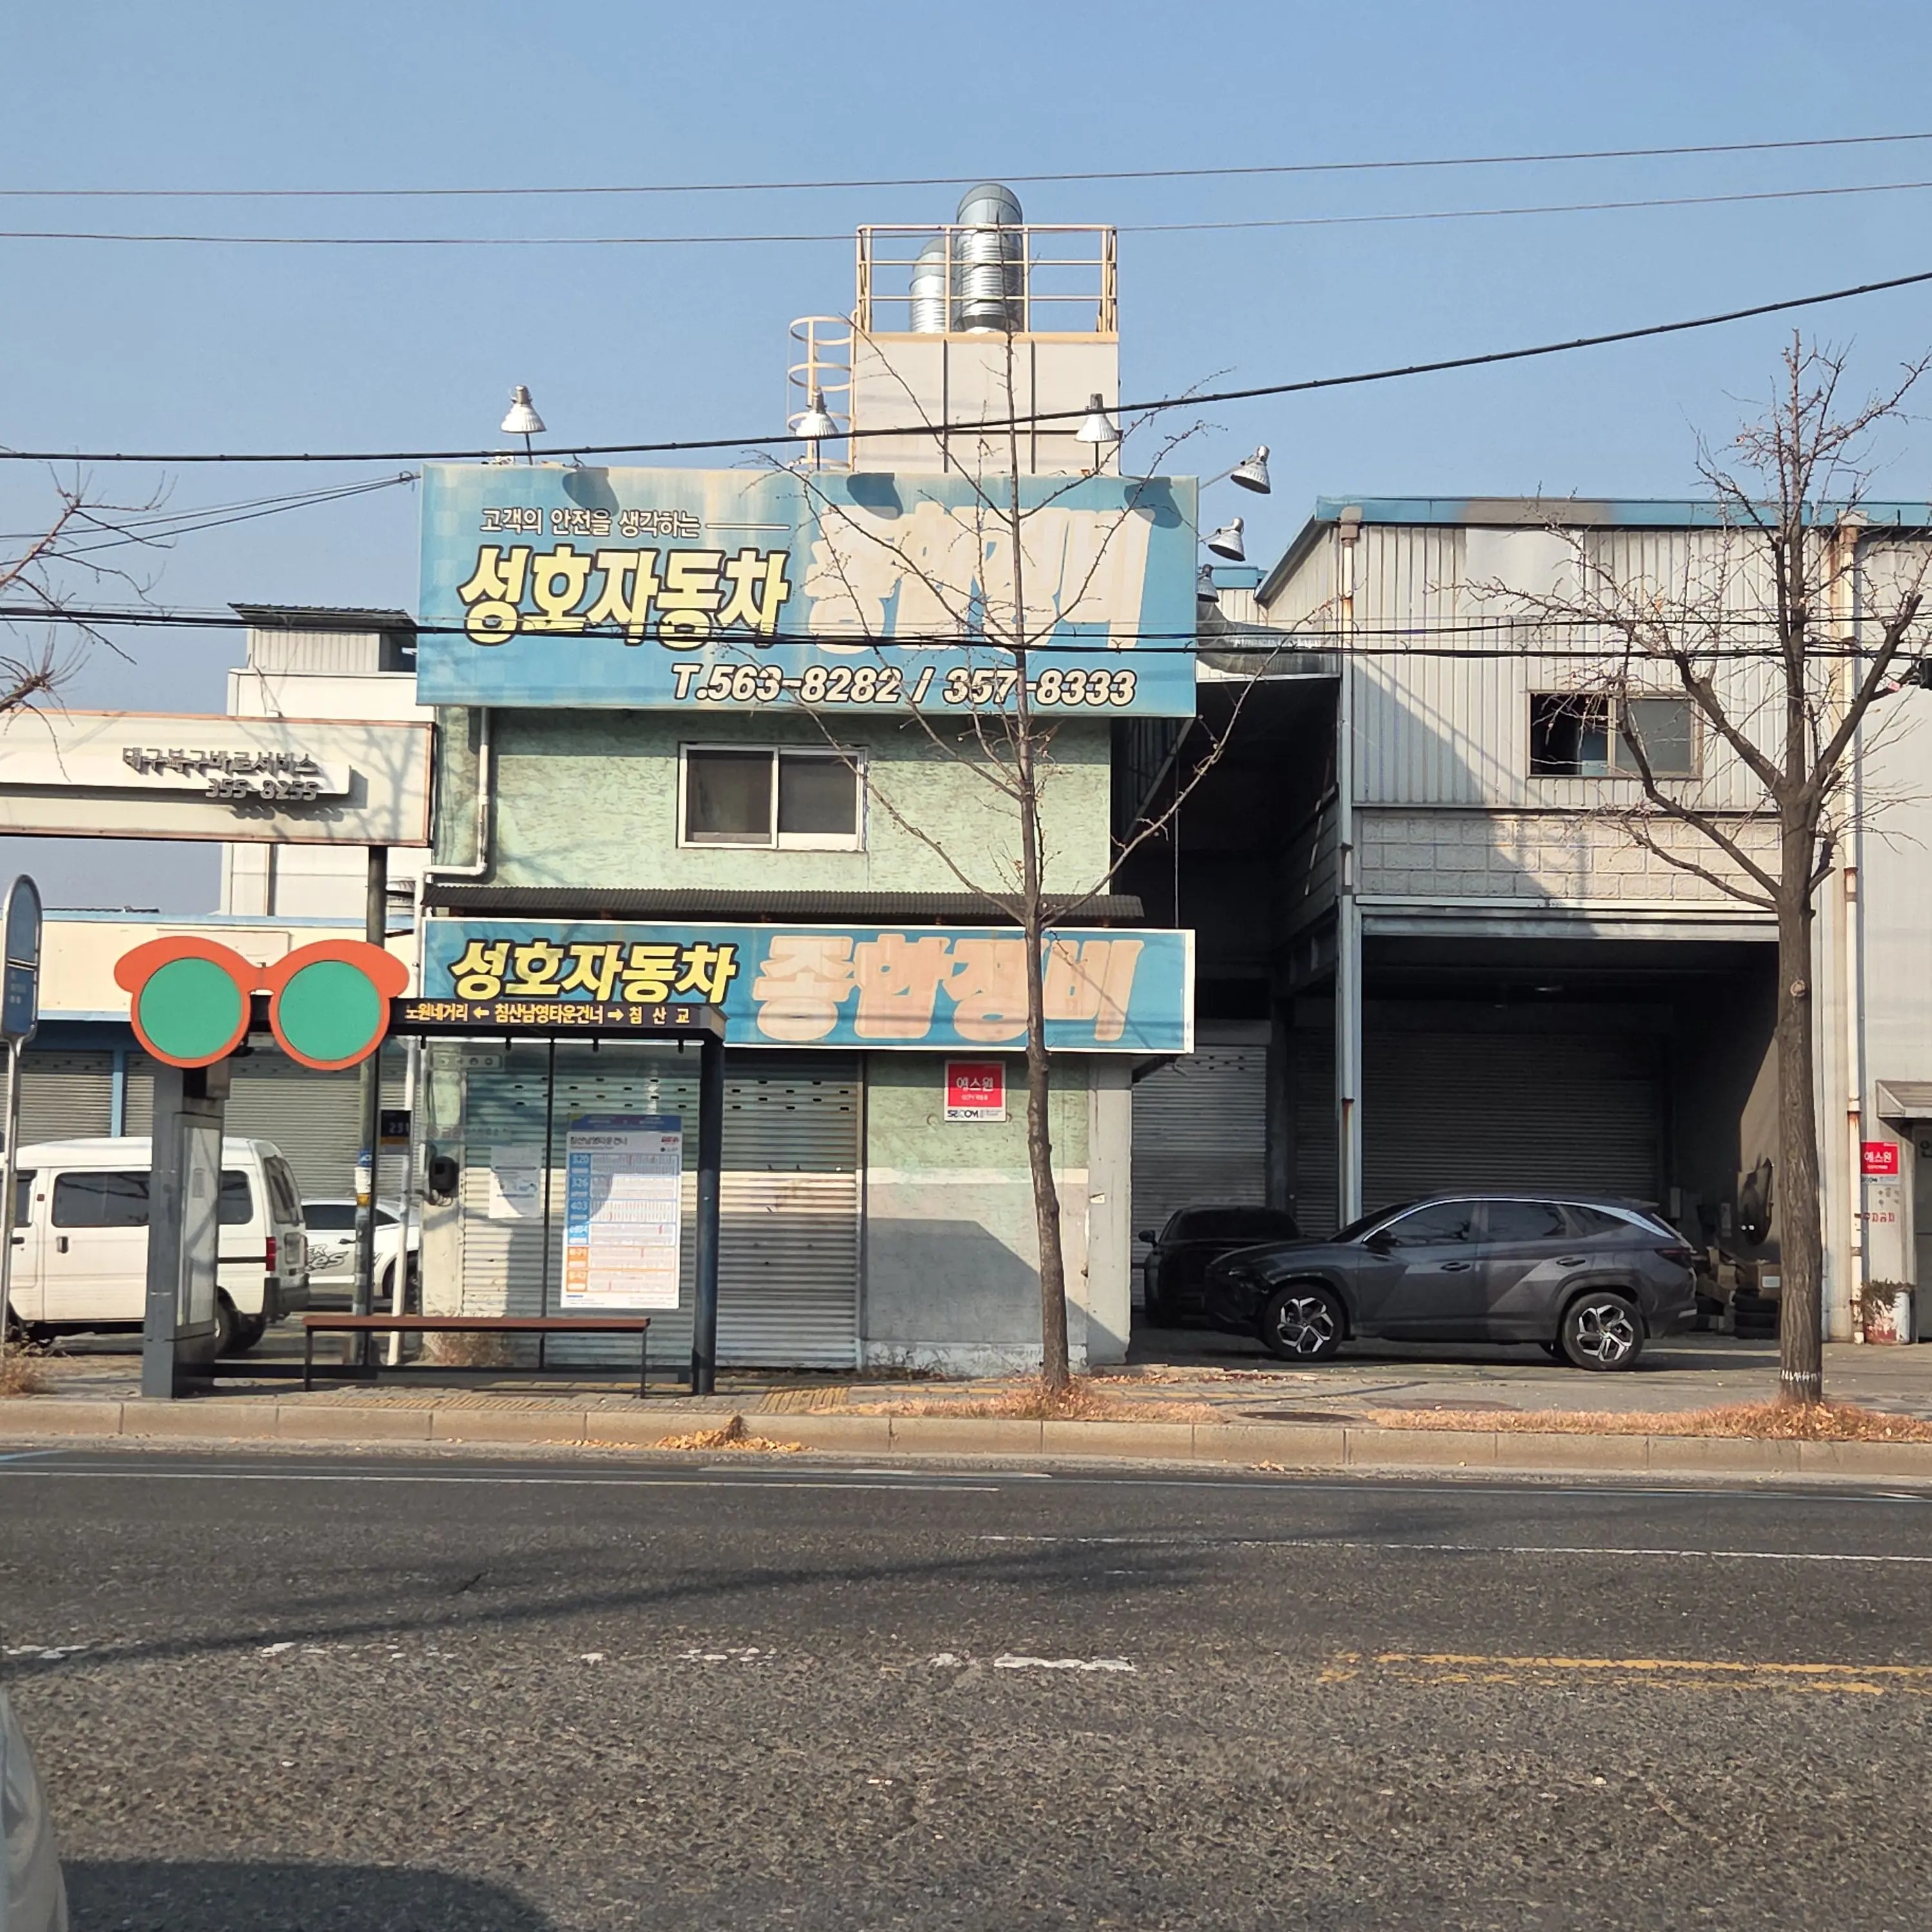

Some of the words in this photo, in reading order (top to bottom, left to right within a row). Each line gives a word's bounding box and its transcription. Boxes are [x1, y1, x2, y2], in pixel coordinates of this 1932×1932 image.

[480, 508, 543, 535] 고객의
[551, 508, 611, 536] 안전을
[618, 511, 700, 538] 생각하는
[457, 544, 790, 650] 성호자동차
[672, 663, 903, 704] T.563-8282
[942, 667, 1137, 708] 357-8333
[448, 938, 740, 1003] 성호자동차
[404, 1003, 469, 1022] 노원네거리
[494, 1003, 604, 1025] 침산남영타운건너
[956, 1076, 994, 1092] 에스원
[1864, 1151, 1892, 1163] 에스원
